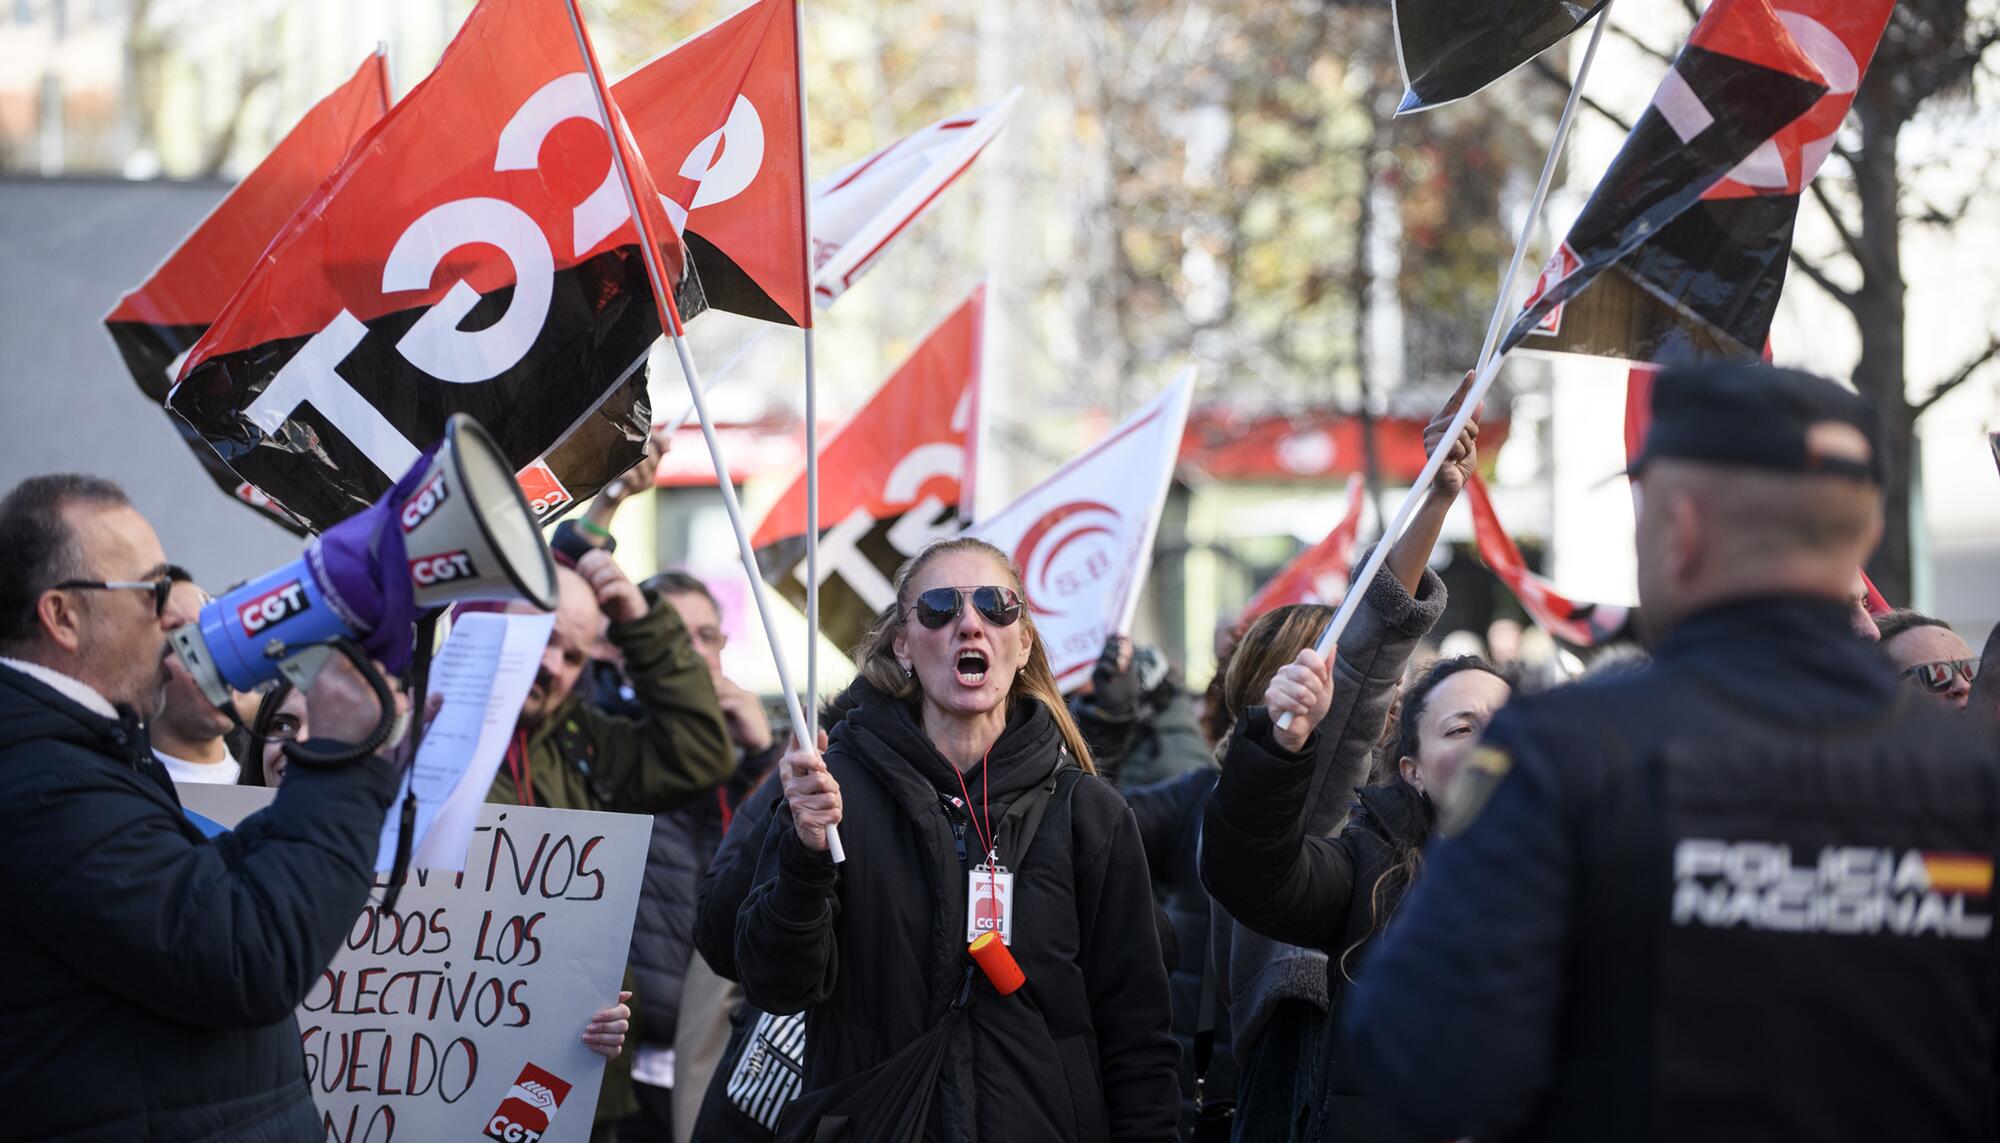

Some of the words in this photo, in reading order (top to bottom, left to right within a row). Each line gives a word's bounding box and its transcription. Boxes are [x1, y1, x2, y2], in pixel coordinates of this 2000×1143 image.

[402, 478, 449, 527] CGT
[412, 554, 474, 585] CGT
[242, 582, 302, 633] CGT
[1674, 838, 1931, 894] POLICIA
[976, 917, 1003, 930] CGT
[1671, 880, 1993, 939] NACIONAL
[347, 905, 450, 955] ODOS
[474, 910, 546, 966] LOS
[489, 1115, 540, 1143] CGT
